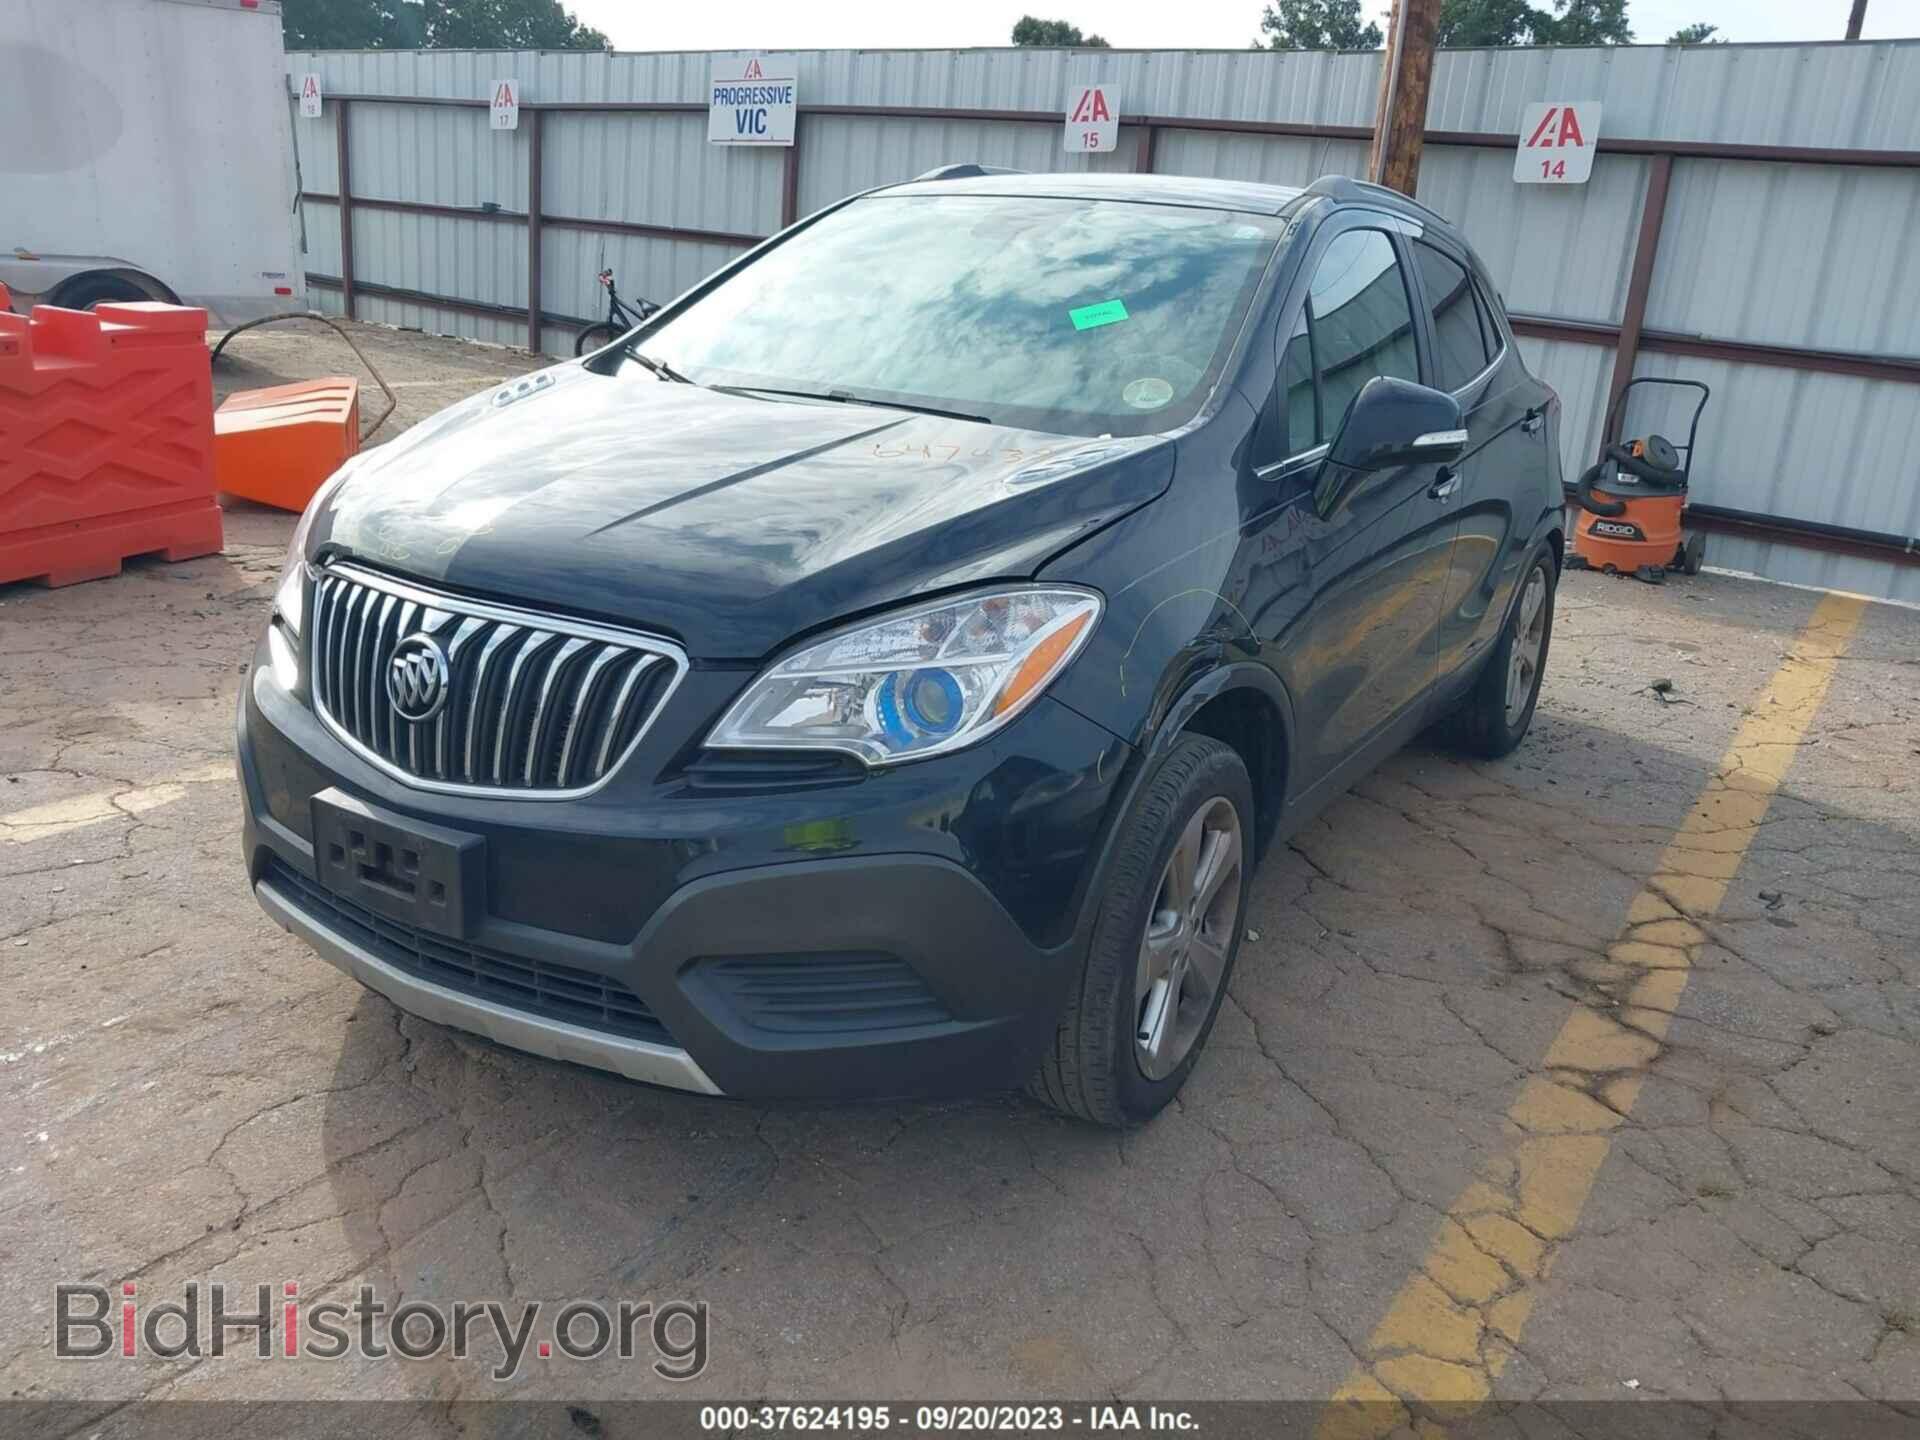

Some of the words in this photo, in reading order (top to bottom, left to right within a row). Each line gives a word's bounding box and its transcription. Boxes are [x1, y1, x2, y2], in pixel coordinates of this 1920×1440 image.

[713, 86, 792, 105] PROGRESSIVE
[736, 108, 767, 134] VIC
[1082, 132, 1099, 149] 15
[1541, 160, 1565, 178] 14
